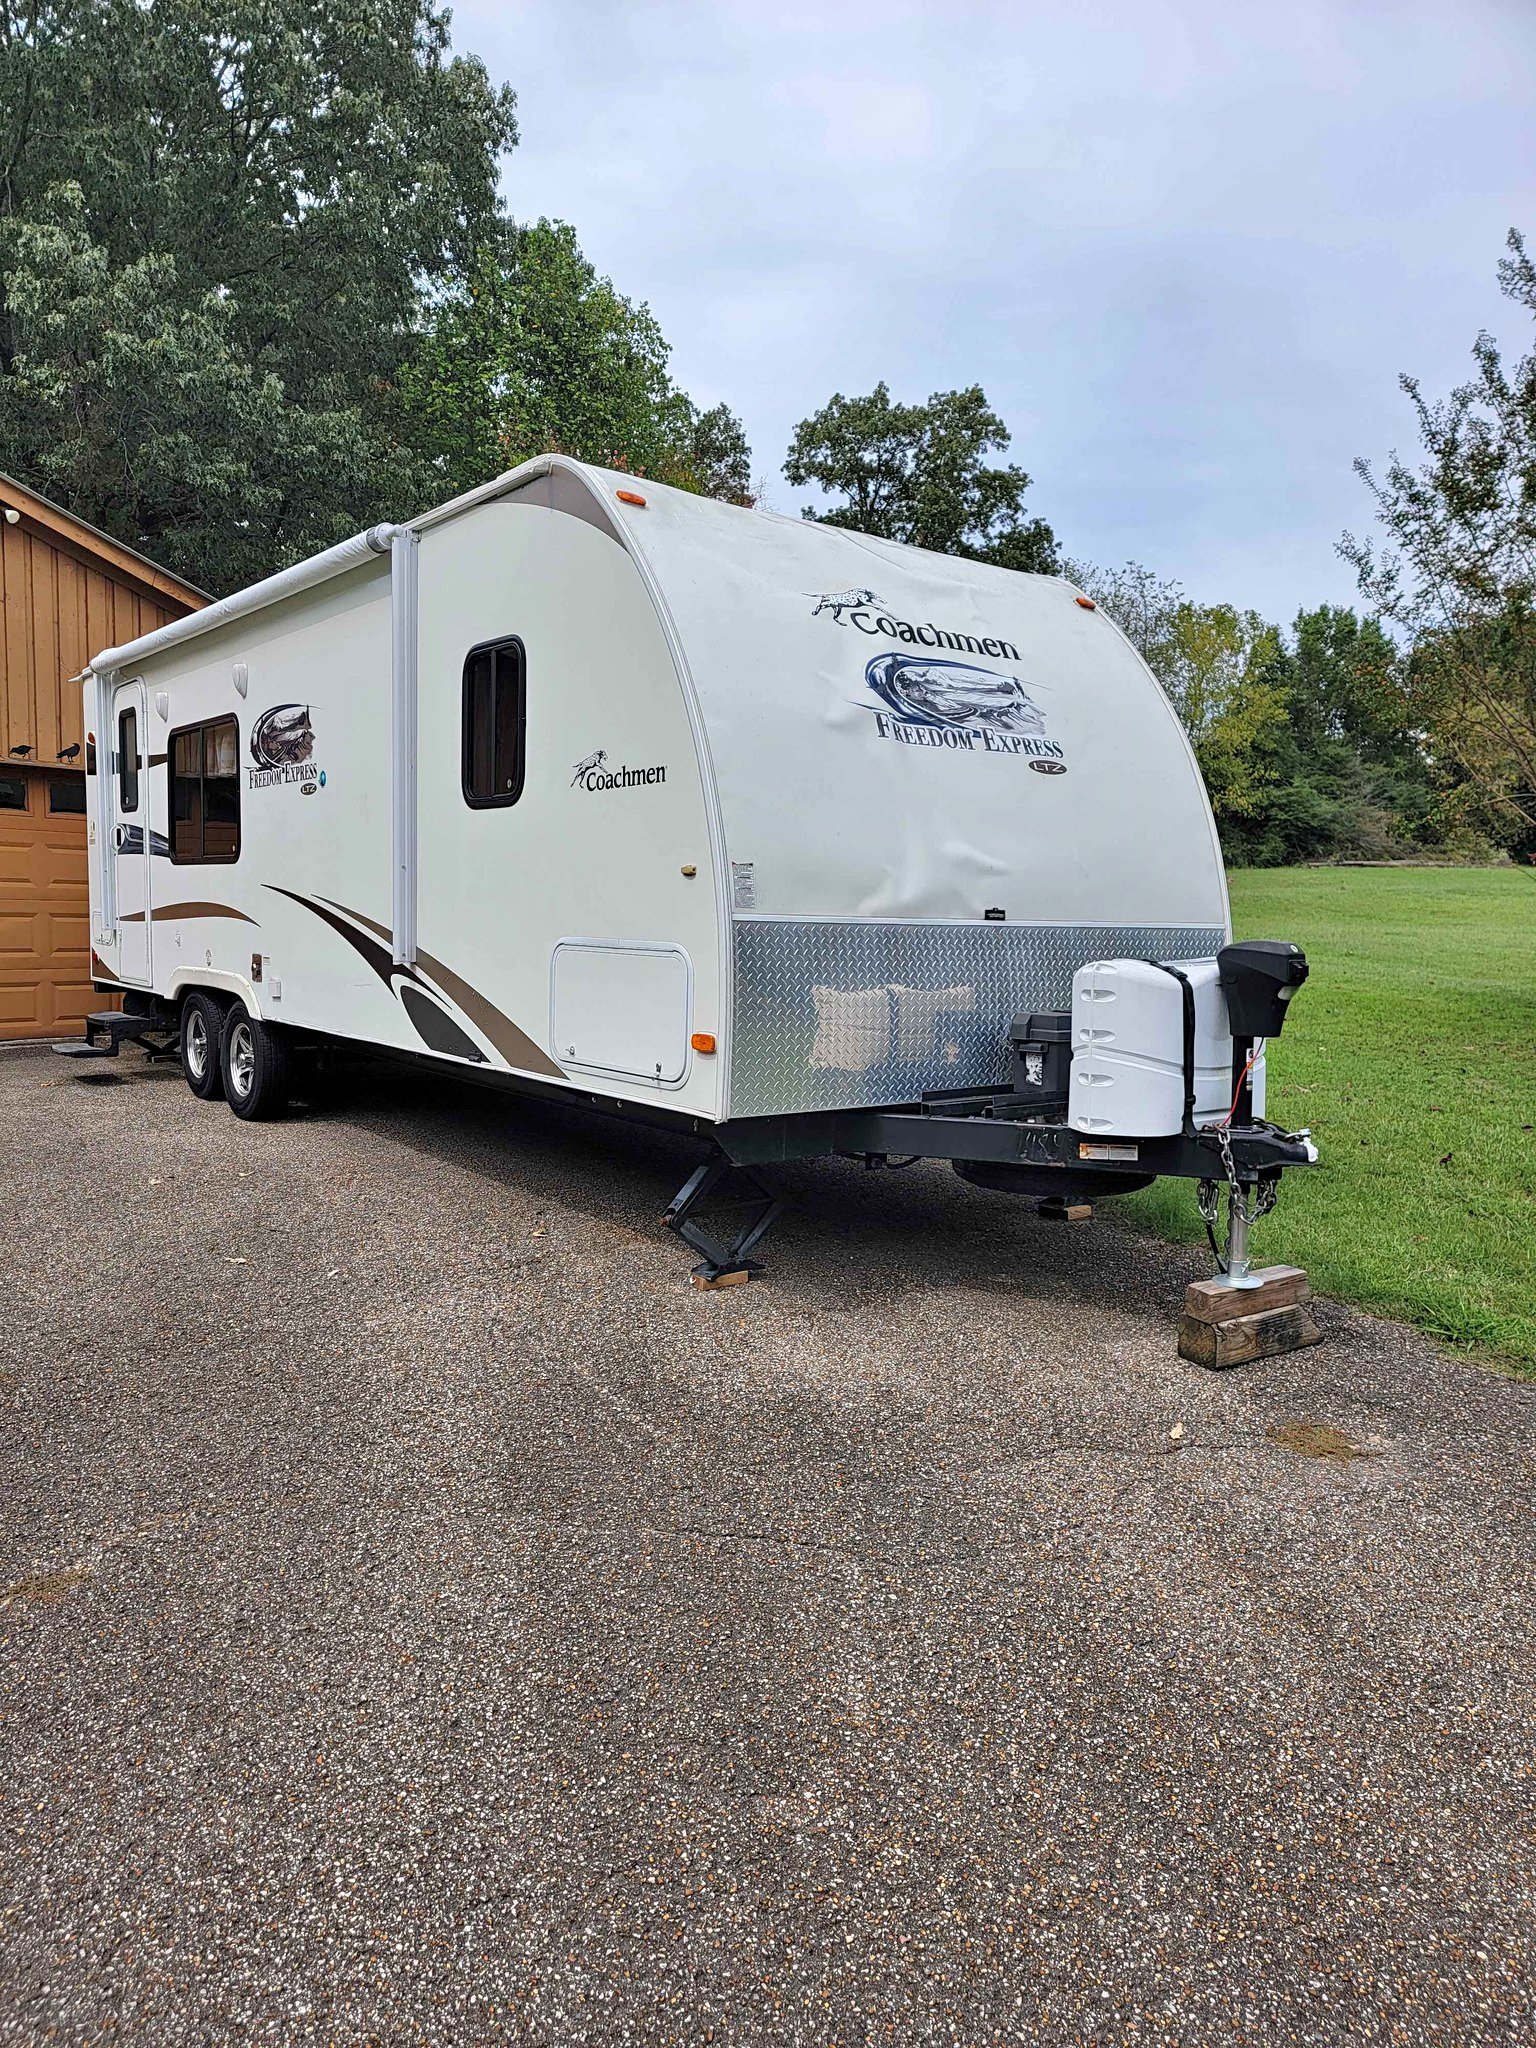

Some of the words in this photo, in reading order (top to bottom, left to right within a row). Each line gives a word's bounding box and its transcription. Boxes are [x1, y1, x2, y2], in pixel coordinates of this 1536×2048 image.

[850, 612, 1022, 661] Coachmen
[874, 712, 976, 750] FREEDOM
[982, 728, 1064, 759] EXPRESS
[249, 769, 282, 789] FREEDOM
[285, 763, 317, 783] EXPRESS
[586, 765, 667, 792] Coachmen
[1032, 761, 1064, 773] LTZ
[301, 785, 316, 794] LTZ
